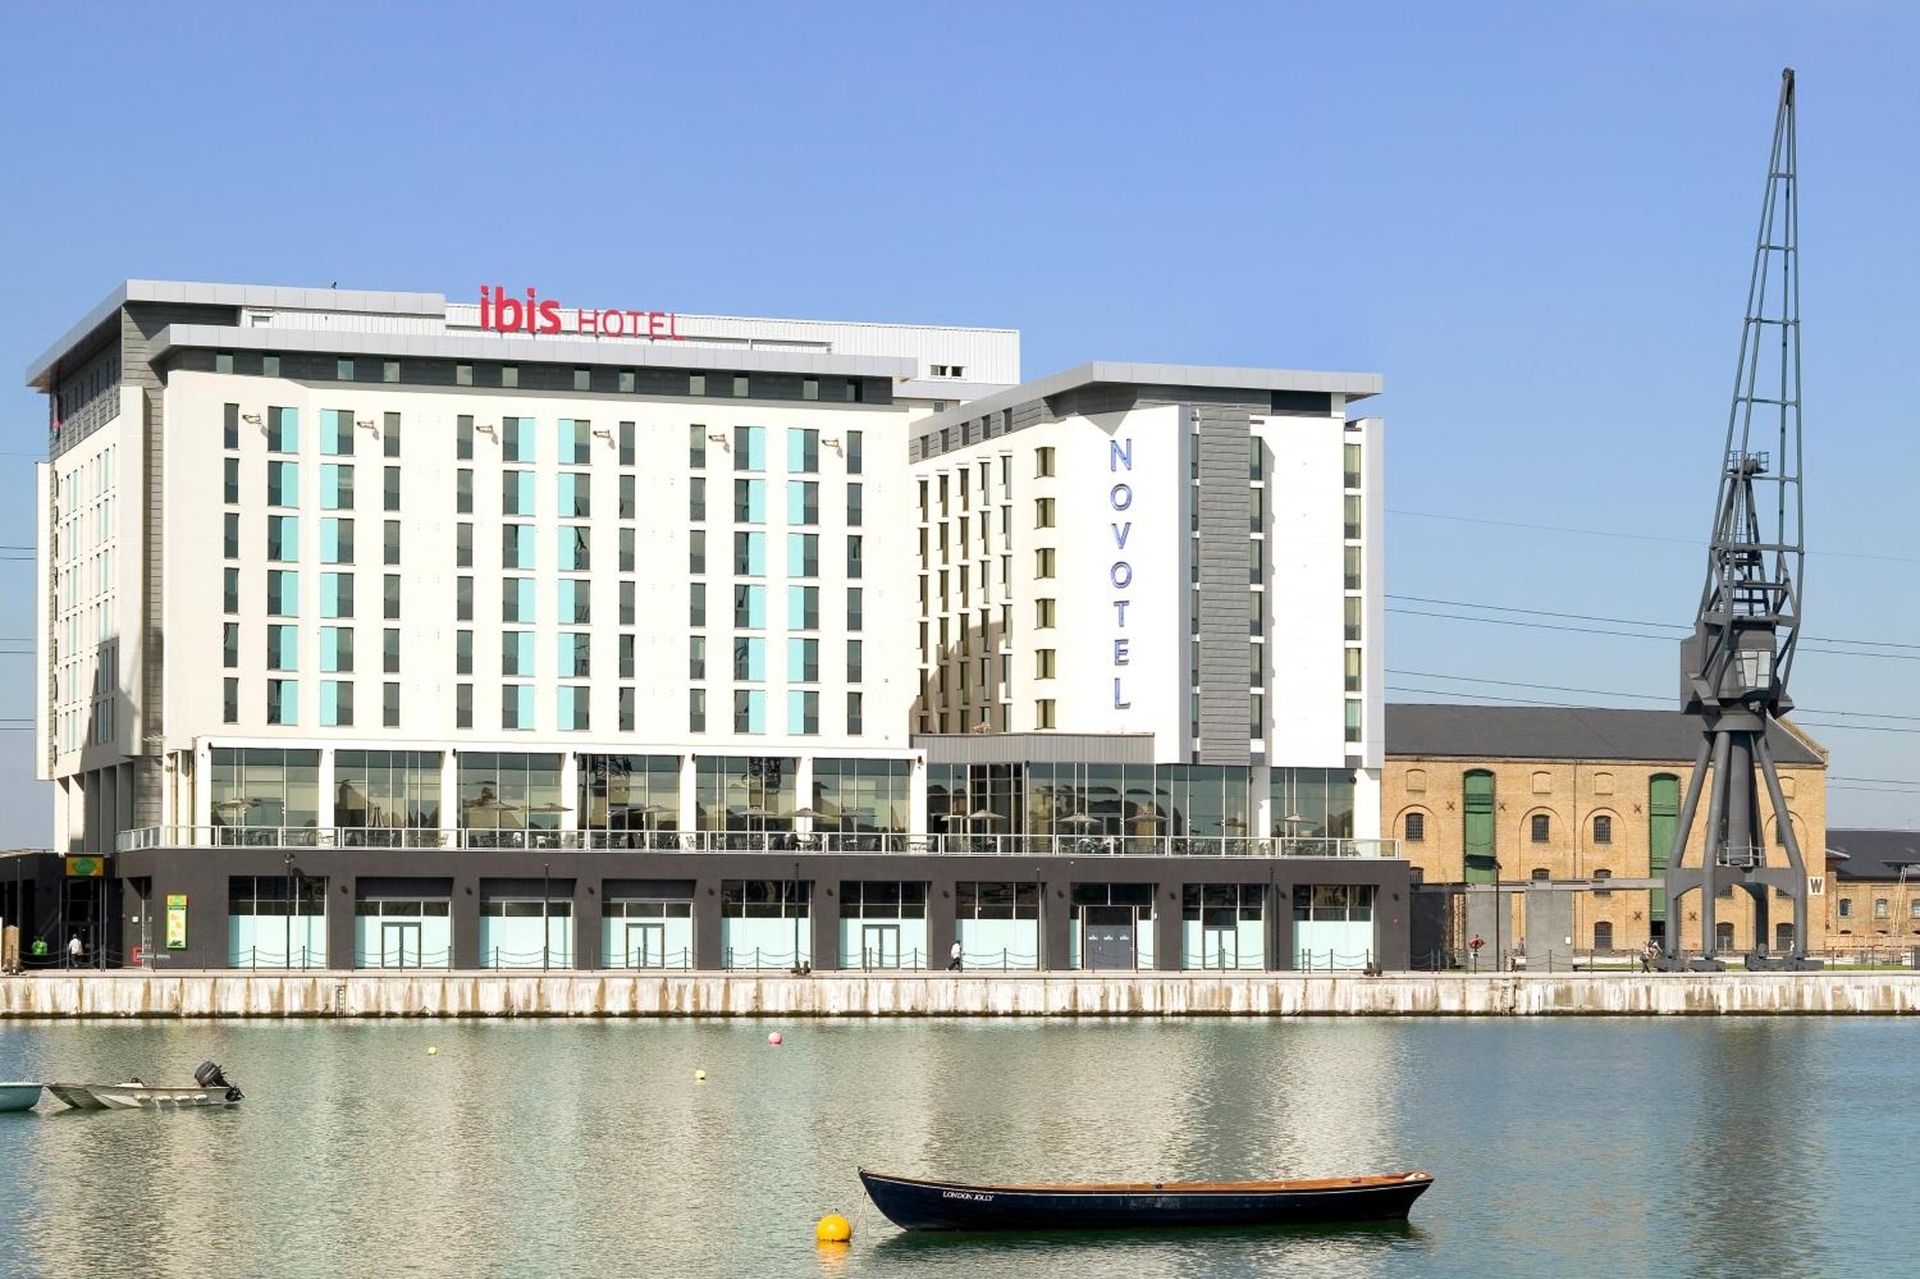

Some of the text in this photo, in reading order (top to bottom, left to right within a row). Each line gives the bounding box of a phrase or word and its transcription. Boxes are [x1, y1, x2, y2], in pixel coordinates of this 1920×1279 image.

[480, 285, 686, 341] ibis HOTEL
[1110, 438, 1133, 710] NOVOTEL
[1810, 878, 1822, 893] W
[942, 1191, 972, 1200] LONDON
